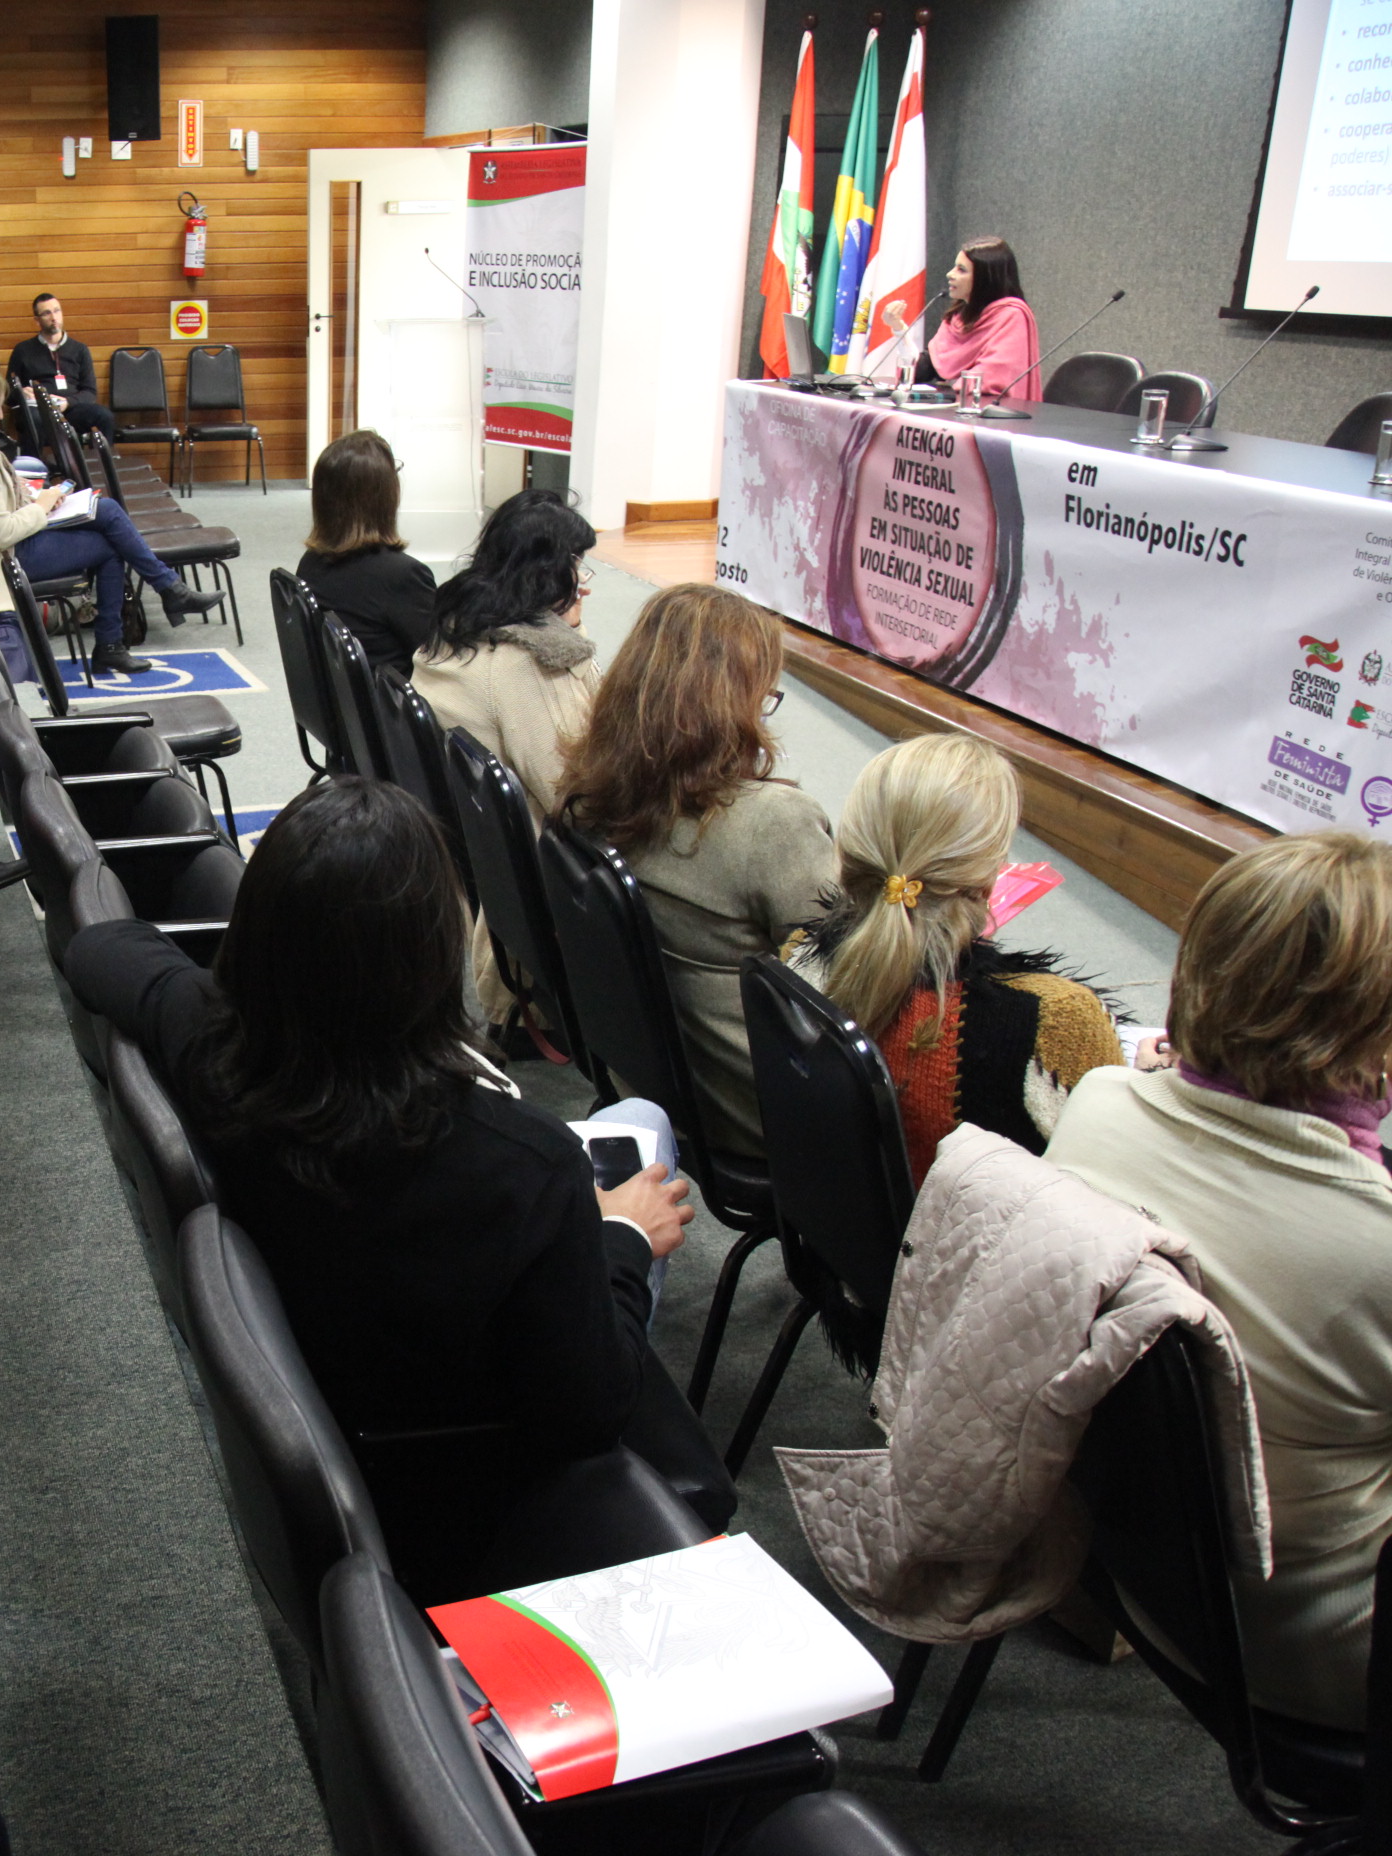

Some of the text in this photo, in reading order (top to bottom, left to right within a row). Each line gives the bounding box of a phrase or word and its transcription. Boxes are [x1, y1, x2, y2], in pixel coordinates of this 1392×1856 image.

[1348, 52, 1392, 72] conhe
[1344, 86, 1392, 105] colabo
[1330, 145, 1390, 168] poderes)
[469, 251, 508, 266] NÚCLEO
[510, 253, 524, 267] DE
[469, 270, 477, 286] E
[479, 268, 538, 289] INCLUSÃO
[769, 399, 817, 423] OFICINA DE
[767, 419, 827, 447] CAPACITAÇÃO
[896, 425, 955, 461] ATENÇÃO
[892, 457, 955, 494] INTEGRAL
[1067, 461, 1098, 487] em
[883, 482, 960, 530] ÀS PESSOAS
[869, 516, 974, 570] EM SITUAÇÃO DE
[1064, 493, 1247, 567] Florianópolis/SC
[1355, 548, 1391, 566] Integral
[860, 546, 975, 607] VIOLÊNCIA SEXUAL
[1353, 566, 1365, 578] de
[866, 583, 959, 631] FORMAÇÃO DE REDE
[1376, 592, 1383, 601] e
[874, 611, 939, 650] INTERSETORIAL
[1291, 680, 1336, 707] DE SANTA
[1293, 669, 1341, 694] GOVERNO
[1289, 693, 1333, 719] CATARINA
[1285, 731, 1344, 760] REDE
[1273, 740, 1345, 787] Feminista
[1274, 770, 1289, 781] DE
[1293, 779, 1333, 800] SAÚDE
